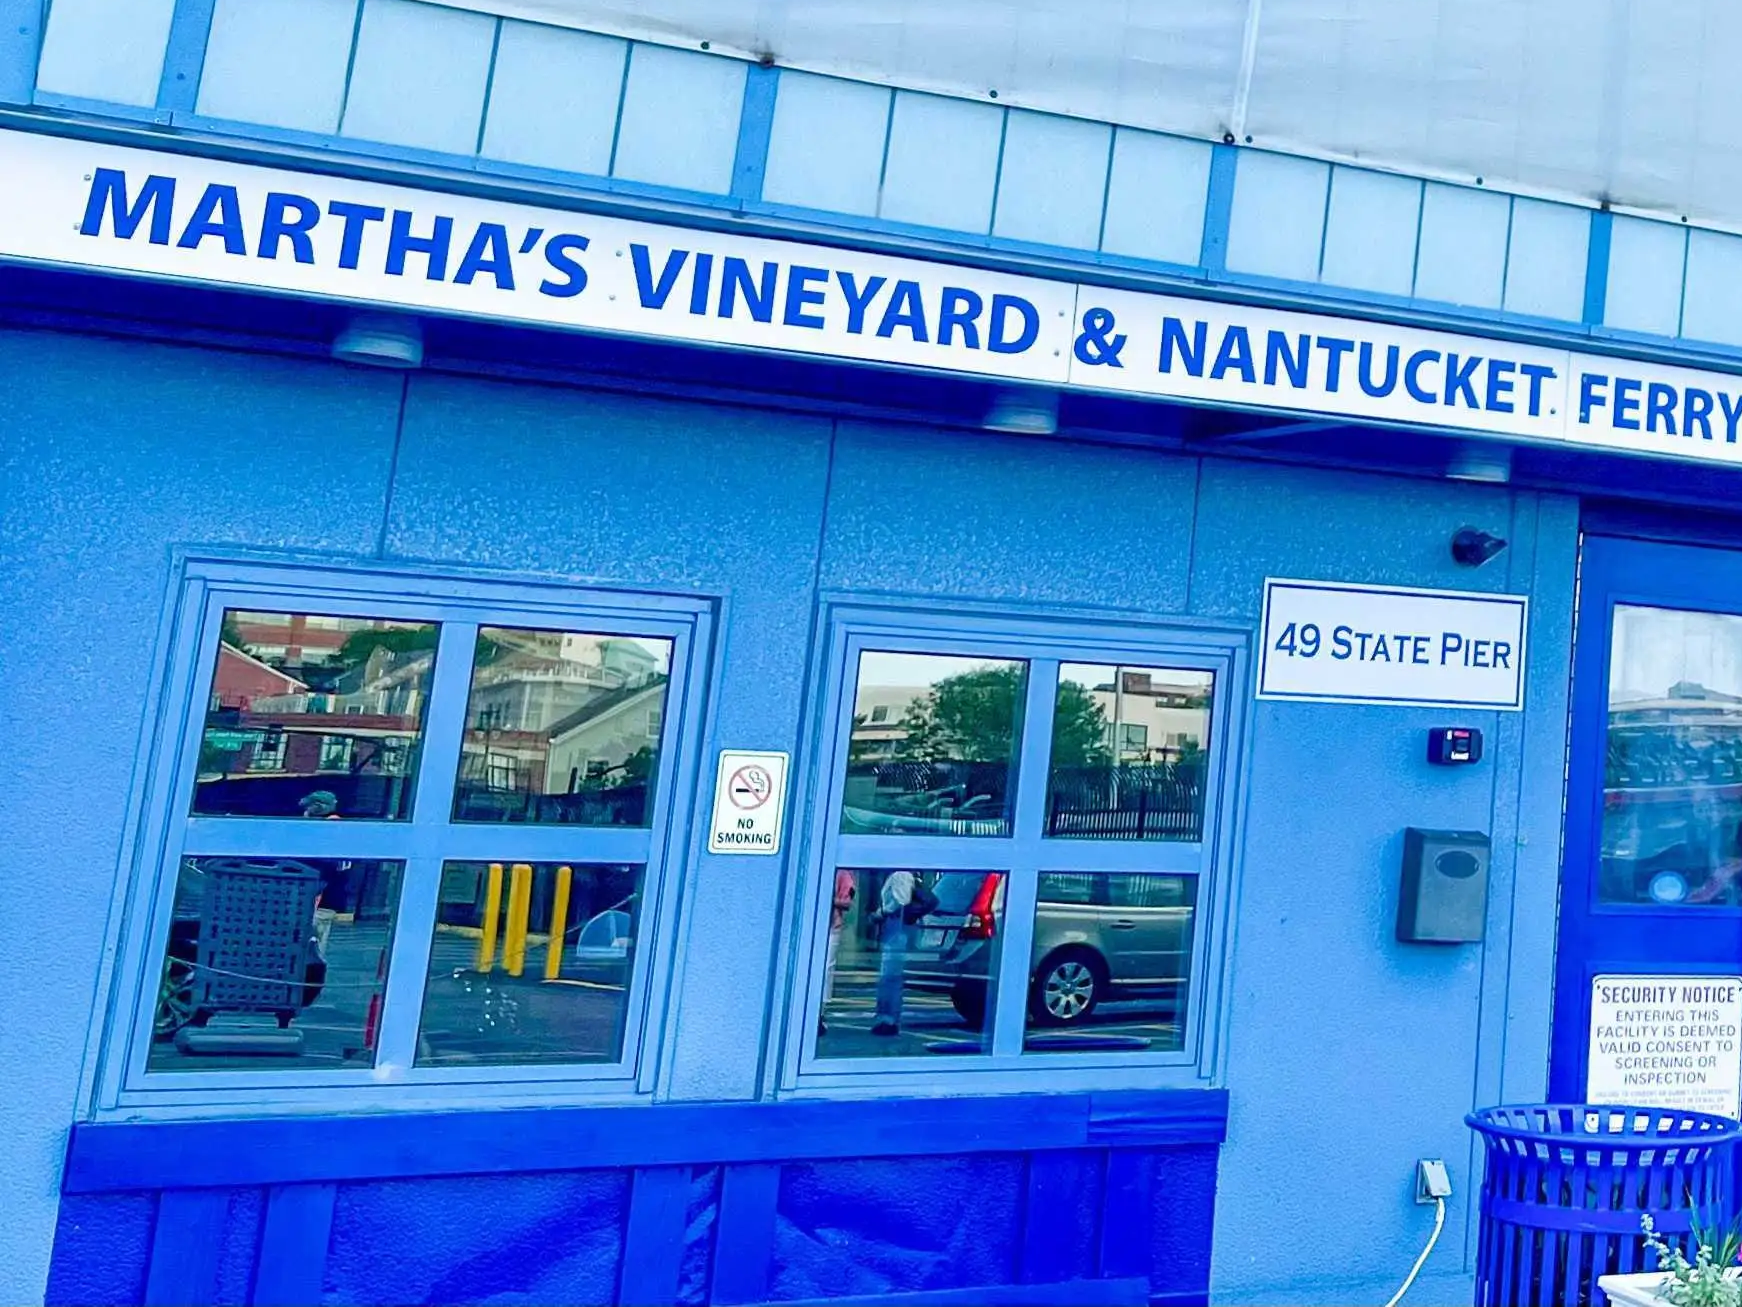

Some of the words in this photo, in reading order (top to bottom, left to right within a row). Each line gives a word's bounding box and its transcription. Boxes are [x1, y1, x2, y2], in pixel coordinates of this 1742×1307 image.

[80, 167, 590, 298] MARTHA'S
[629, 242, 1042, 355] VINEYARD
[1074, 307, 1126, 368] &
[1158, 317, 1553, 418] NANTUCKET
[1275, 622, 1321, 657] 49
[1331, 625, 1431, 664] STATE
[1440, 632, 1511, 669] PIER
[737, 818, 754, 829] NO
[717, 832, 772, 844] SMOKING
[1601, 986, 1678, 1004] SECURITY
[1682, 986, 1735, 1004] NOTICE
[1616, 1009, 1685, 1022] ENTERING
[1690, 1009, 1719, 1022] THIS
[1596, 1025, 1659, 1039] FACILITY
[1663, 1025, 1675, 1038] IS
[1680, 1025, 1736, 1037] DEEMED
[1599, 1041, 1641, 1054] VALID
[1646, 1041, 1710, 1054] CONSENT
[1717, 1040, 1733, 1052] TO
[1615, 1056, 1694, 1069] SCREENING
[1698, 1056, 1717, 1068] OR
[1624, 1072, 1707, 1085] INSPECTION
